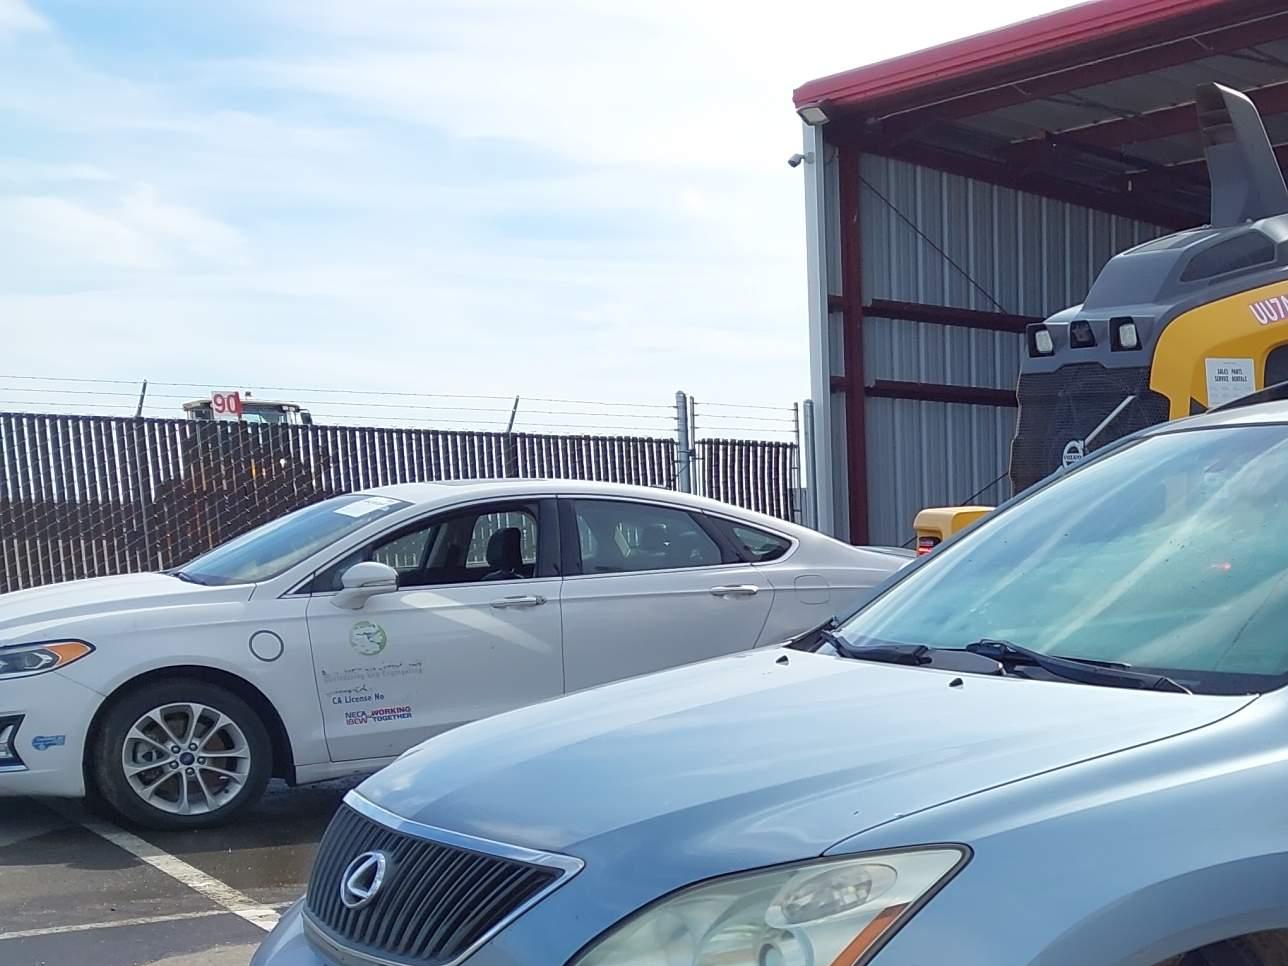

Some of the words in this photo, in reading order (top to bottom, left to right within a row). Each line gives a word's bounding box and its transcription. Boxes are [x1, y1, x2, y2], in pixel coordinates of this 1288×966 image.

[213, 394, 238, 414] 90
[332, 696, 342, 705] CA
[371, 706, 412, 716] WORKING
[373, 712, 412, 723] TOGETHER
